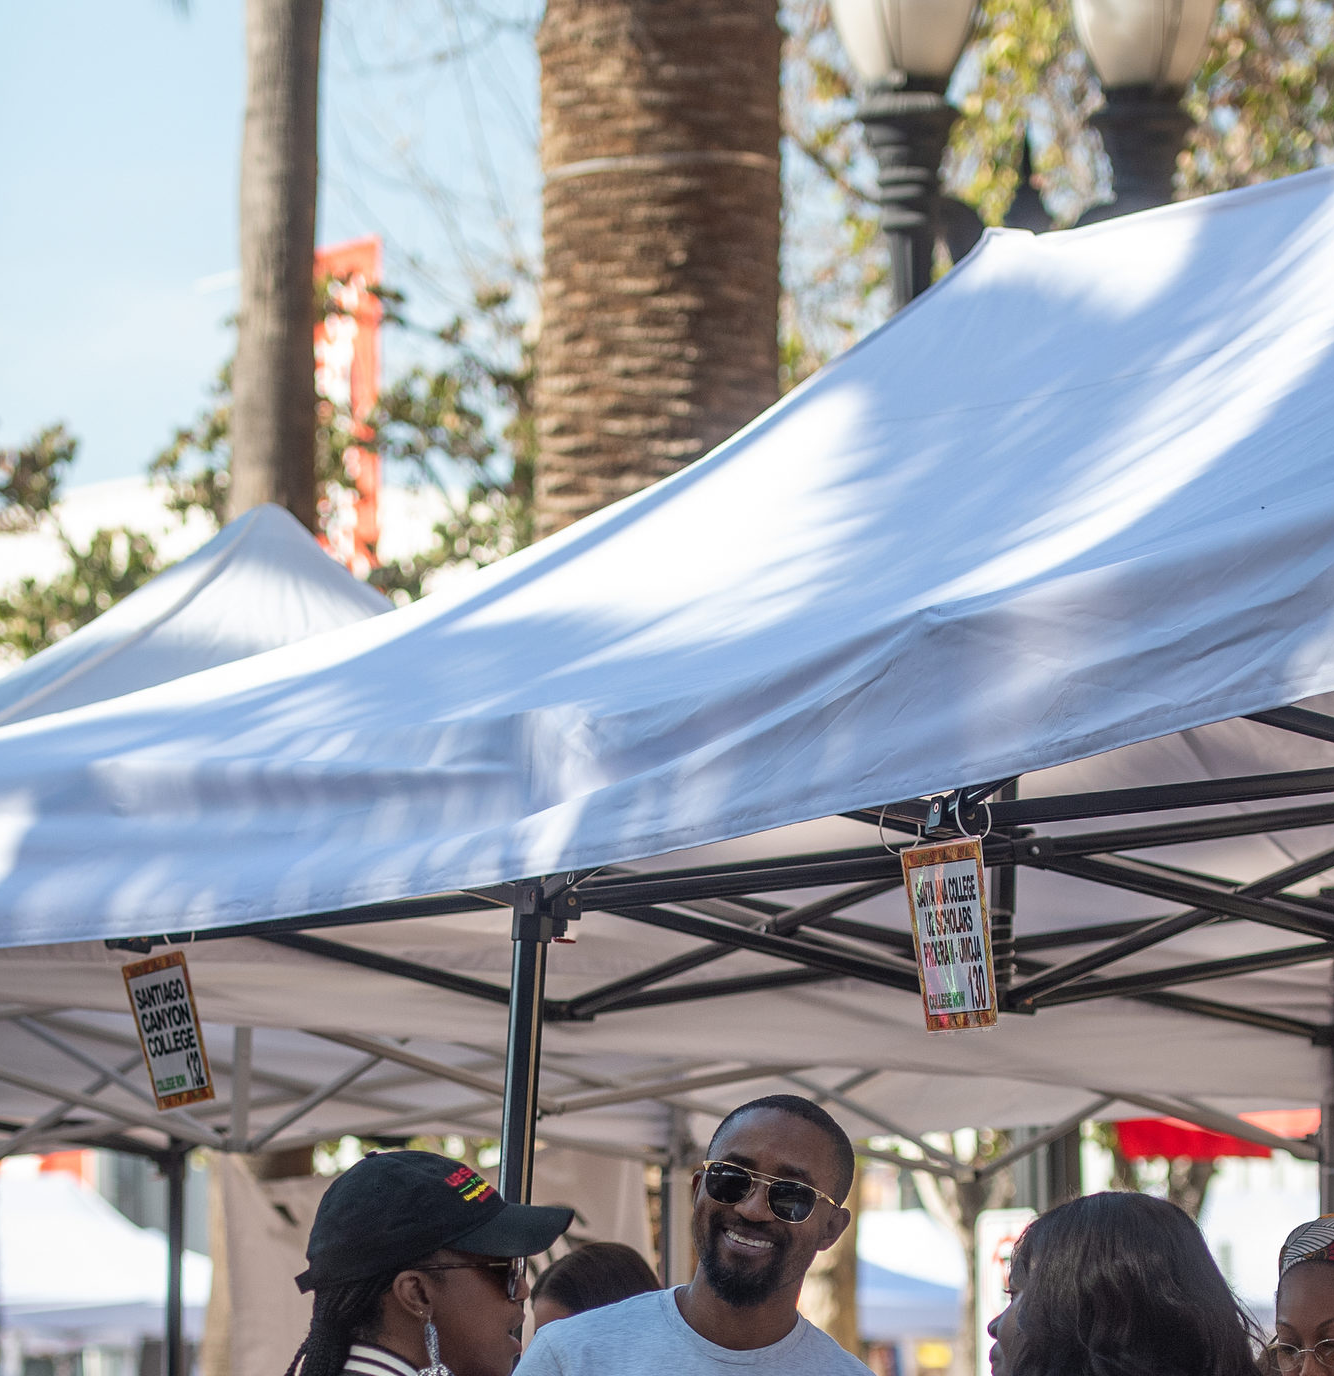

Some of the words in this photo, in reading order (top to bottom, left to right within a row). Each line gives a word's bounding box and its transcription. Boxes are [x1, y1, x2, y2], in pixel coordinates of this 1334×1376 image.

[134, 978, 185, 1010] SANTIAGO
[968, 965, 987, 1010] 130
[141, 1003, 192, 1034] CANYON
[147, 1028, 197, 1059] COLLEGE
